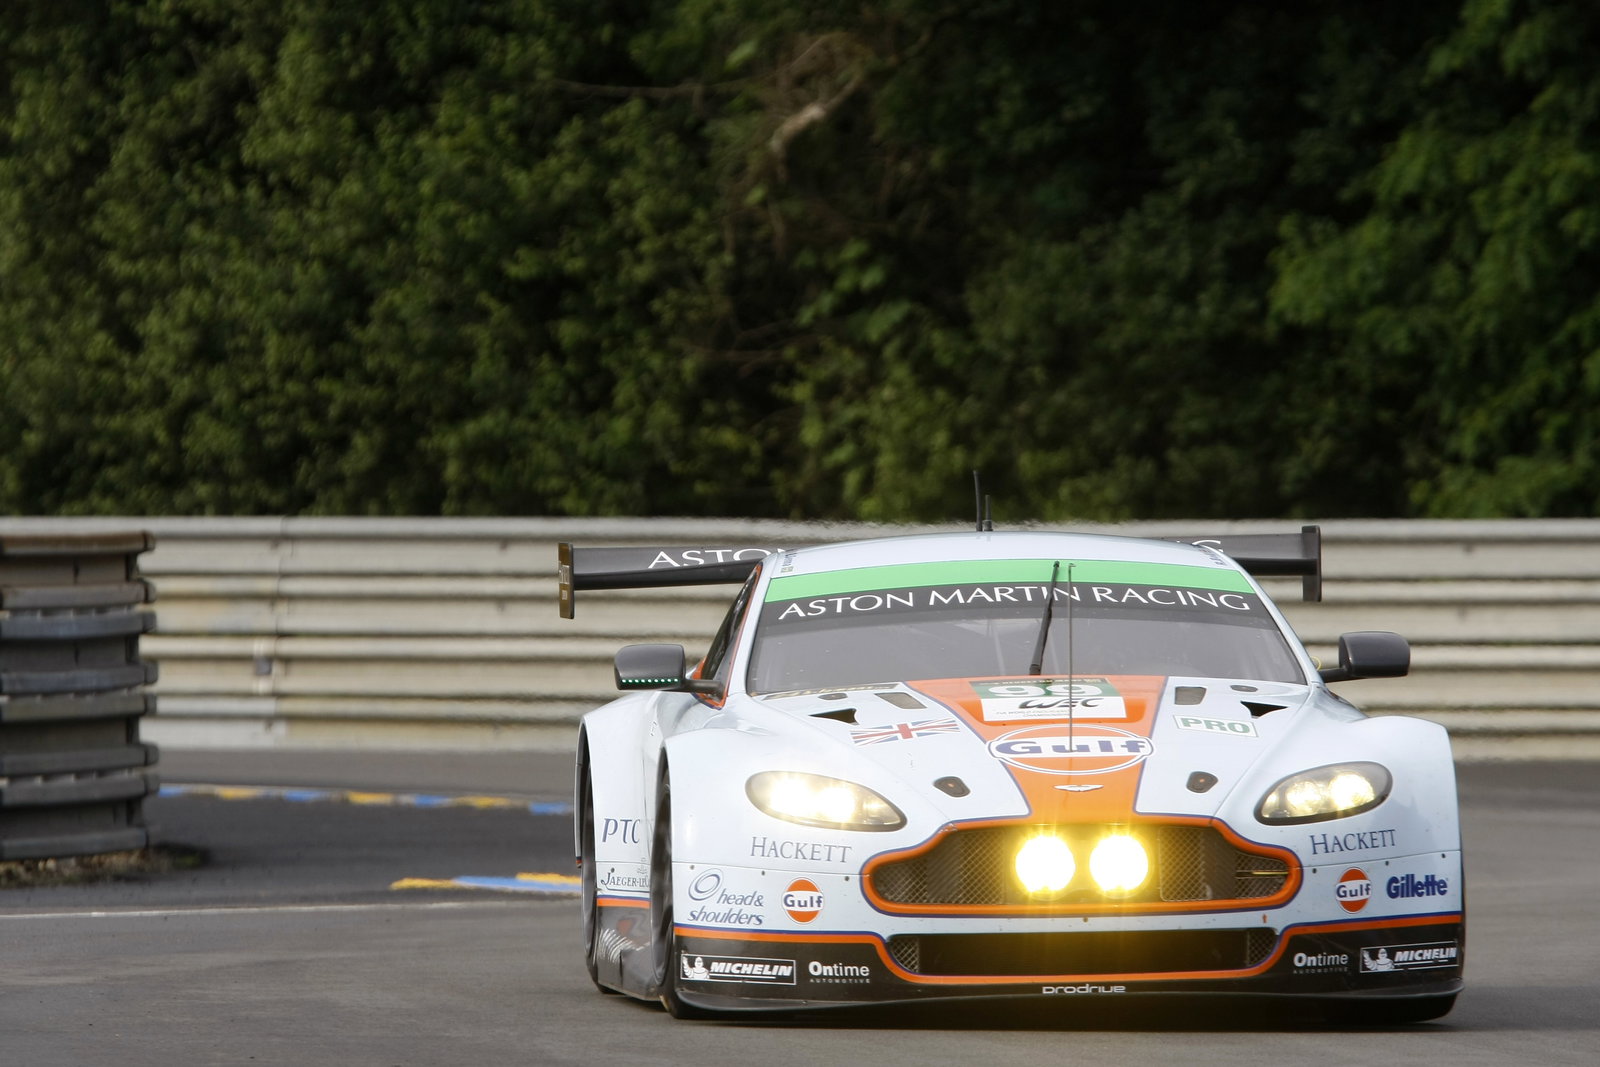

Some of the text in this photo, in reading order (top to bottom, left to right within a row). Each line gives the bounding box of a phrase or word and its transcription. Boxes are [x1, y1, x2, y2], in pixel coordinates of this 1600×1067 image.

[648, 549, 784, 568] ASTO
[779, 585, 1251, 619] ASTON MARTIN RACING
[988, 684, 1103, 697] 99
[1180, 717, 1250, 733] PRO
[995, 740, 1147, 755] Gulf
[602, 818, 640, 844] PTC
[751, 836, 852, 863] HACKETT
[1310, 829, 1396, 855] HACKETT
[1336, 884, 1371, 898] Gulf
[1386, 874, 1448, 899] Gillette
[783, 893, 823, 908] Gulf
[687, 905, 764, 925] shoulders
[1293, 952, 1348, 967] Ontime
[1394, 947, 1457, 962] MICHELIN
[709, 961, 793, 977] MICHELIN
[808, 961, 870, 977] Ontime
[1042, 983, 1126, 994] prodrive
